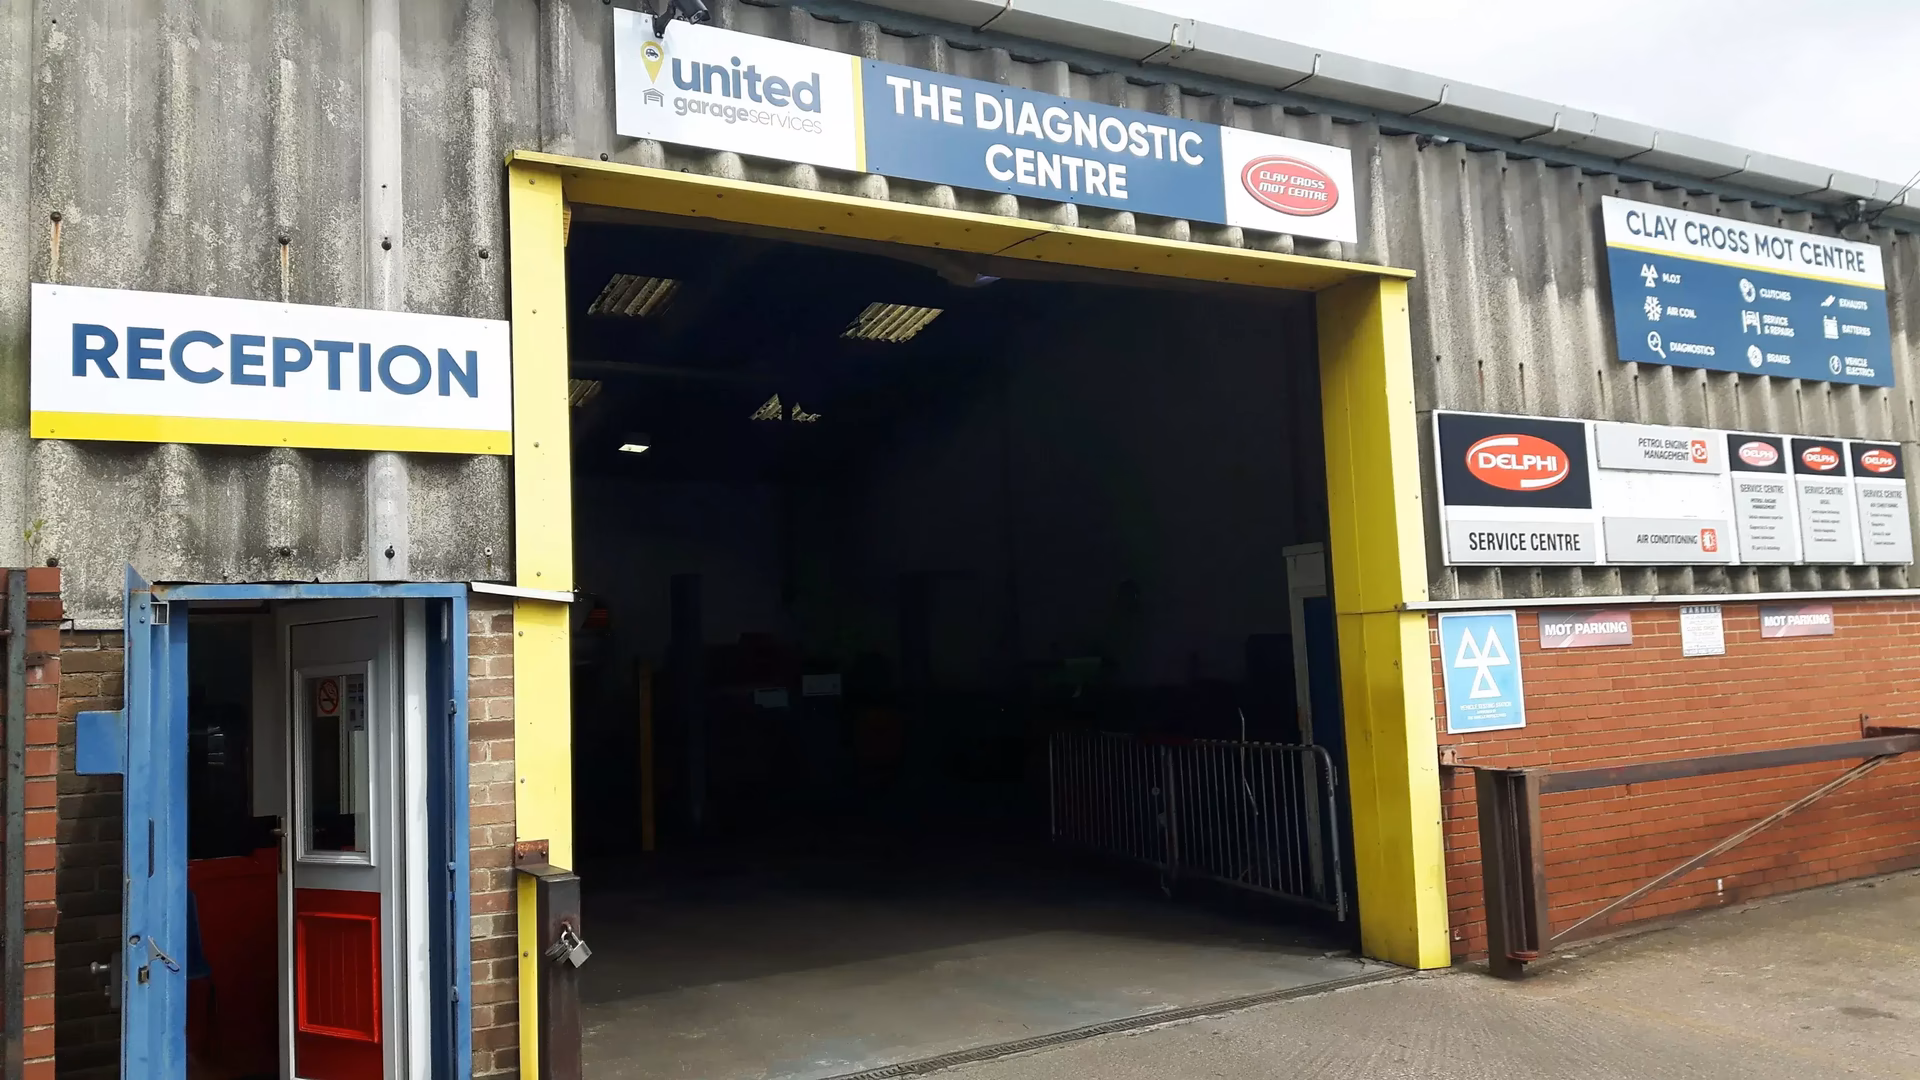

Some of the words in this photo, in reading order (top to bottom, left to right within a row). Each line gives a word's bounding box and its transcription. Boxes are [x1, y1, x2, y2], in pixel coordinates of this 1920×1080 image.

[672, 56, 822, 114] united
[886, 75, 964, 126] THE
[974, 92, 1204, 166] DIAGNOSTIC
[985, 144, 1128, 200] CENTRE
[1260, 170, 1289, 183] CLAY
[1290, 176, 1326, 189] CROSS
[1259, 182, 1286, 194] MOT
[1288, 187, 1328, 201] CENTRE
[1626, 210, 1677, 242] CLAY
[1684, 220, 1750, 255] CROSS
[1755, 233, 1794, 261] MOT
[1800, 242, 1866, 273] CENTRE
[1759, 288, 1792, 302] CLUTCHES
[1838, 298, 1868, 310] EXHAUSTS
[1666, 306, 1679, 316] AIR
[1762, 314, 1788, 326] SERVICE
[1770, 326, 1795, 338] REPAIRS
[1842, 324, 1872, 336] BATTERIES
[1670, 342, 1716, 356] DIAGNOSTICS
[71, 322, 479, 399] RECEPTION
[1766, 353, 1791, 364] BRAKES
[1844, 356, 1868, 368] VEHICLE
[1846, 366, 1876, 378] ELECTRICS
[1638, 437, 1664, 448] PETROL
[1664, 439, 1689, 450] ENGINE
[1644, 449, 1690, 461] MANAGEMENT
[1742, 449, 1774, 458] DELPHI
[1806, 454, 1836, 464] DELPHI
[1478, 452, 1558, 473] DELPHI
[1865, 456, 1893, 466] DELPHI
[1740, 484, 1763, 492] SERVICE
[1764, 484, 1784, 494] CENTRE
[1469, 532, 1527, 551] SERVICE
[1530, 532, 1581, 552] CENTRE
[1636, 534, 1649, 544] AIR
[1650, 534, 1698, 544] CONDITIONING
[1764, 614, 1786, 628] MOT
[1786, 613, 1831, 626] PARKING
[1544, 622, 1573, 637] MOT
[1574, 620, 1628, 636] PARKING
